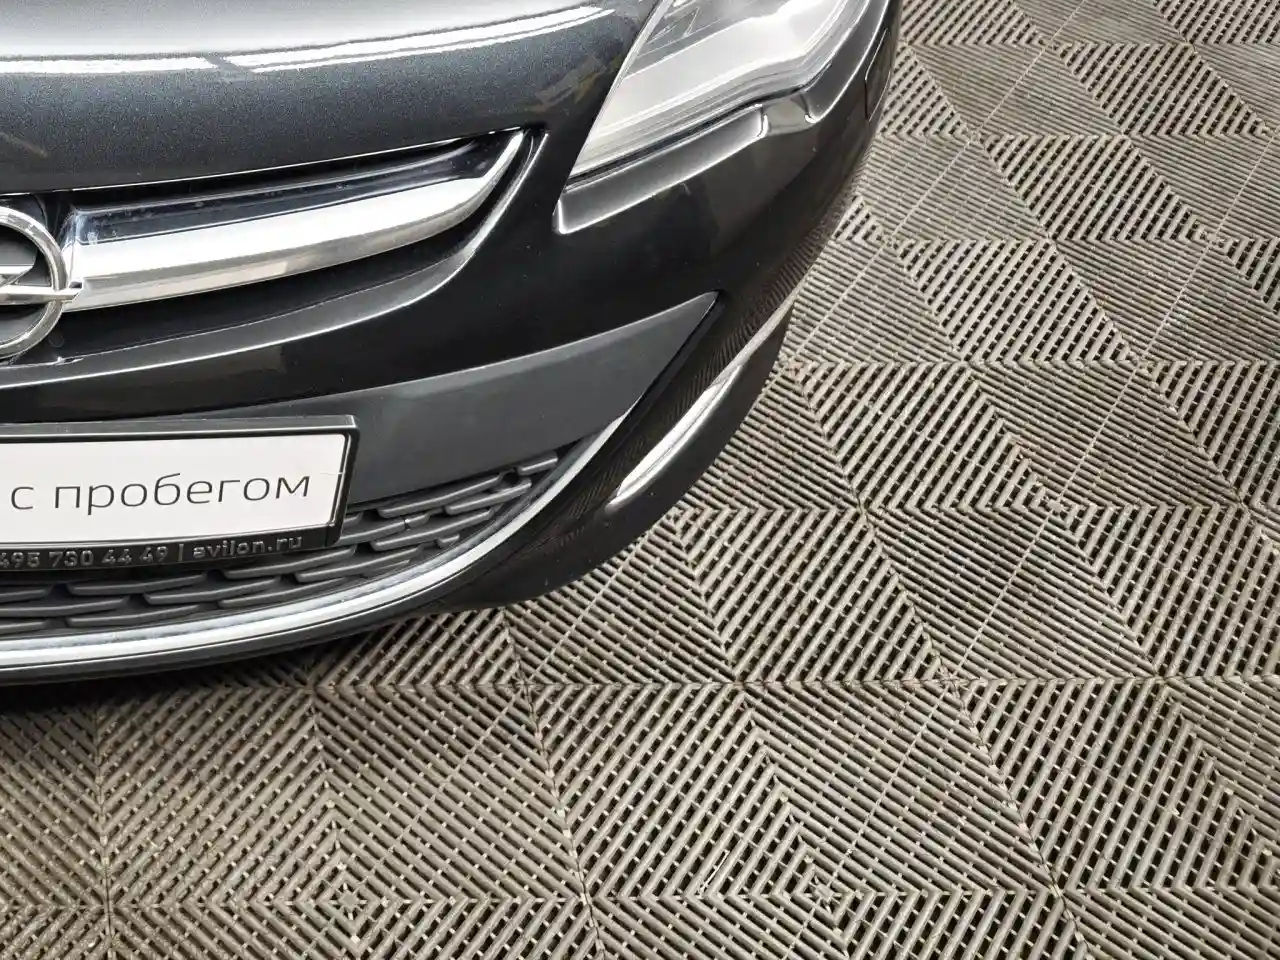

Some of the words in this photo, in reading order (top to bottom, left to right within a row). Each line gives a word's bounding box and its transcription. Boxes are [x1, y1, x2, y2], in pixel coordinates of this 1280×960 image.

[10, 485, 35, 511] с
[54, 472, 311, 516] пробегом
[48, 549, 95, 568] 730
[101, 548, 133, 567] 44
[139, 546, 170, 564] 49
[192, 535, 304, 560] avilon.ru
